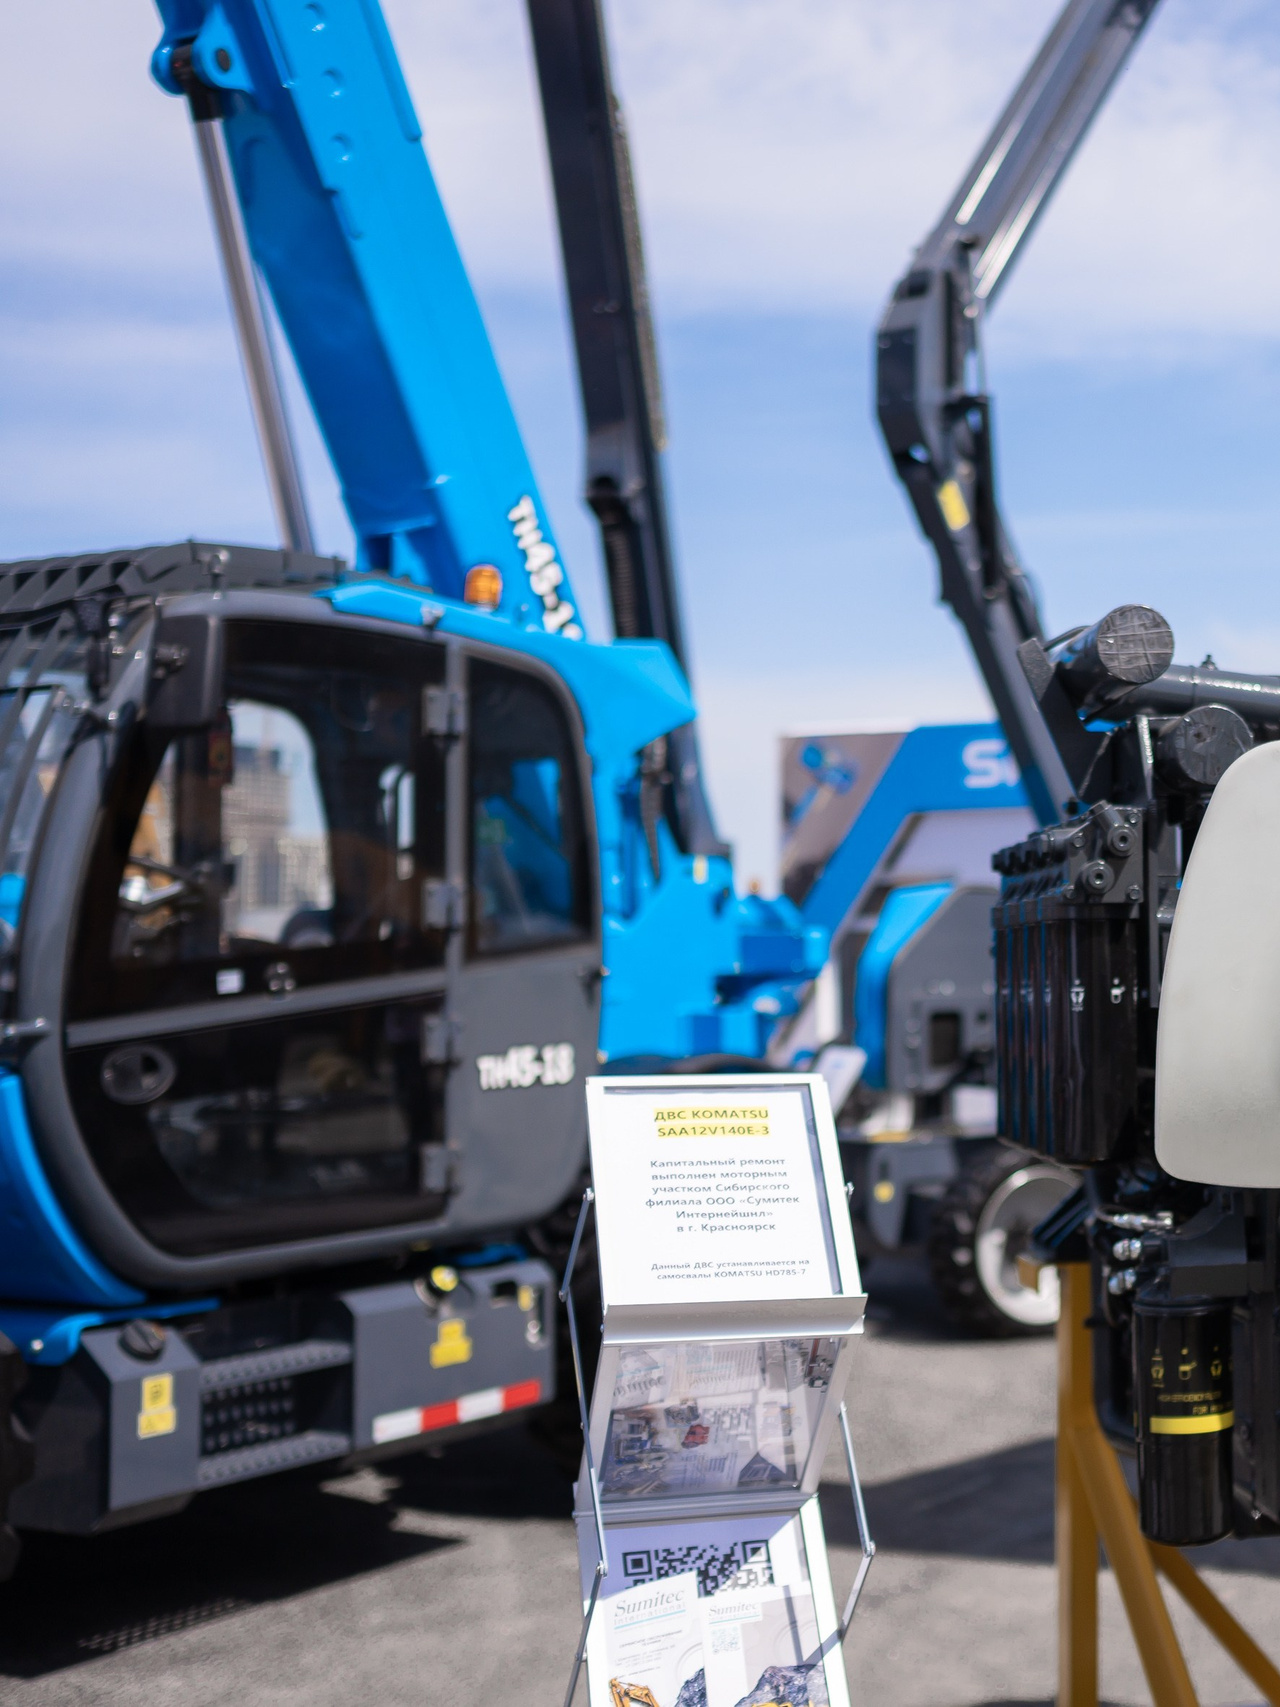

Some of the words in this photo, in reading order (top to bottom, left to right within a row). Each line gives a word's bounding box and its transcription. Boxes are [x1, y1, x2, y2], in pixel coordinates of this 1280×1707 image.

[654, 1110, 686, 1122] ДВС
[691, 1109, 769, 1119] KOMATSU
[657, 1126, 770, 1137] SAA12V140E-3
[650, 1157, 736, 1168] Капитальный
[740, 1158, 785, 1167] ремонт
[651, 1172, 716, 1181] выполнен
[720, 1170, 787, 1180] моторным
[651, 1185, 711, 1195] участком
[715, 1183, 790, 1193] Сибирского
[645, 1198, 702, 1208] филиала
[706, 1197, 735, 1205] ООО
[739, 1196, 800, 1206] «Сумитек
[701, 1223, 776, 1233] Красноярск
[651, 1262, 691, 1271] Данный
[693, 1261, 714, 1270] ДВС
[716, 1259, 795, 1269] устанавливается
[714, 1270, 762, 1278] KOMATSU
[614, 1590, 685, 1617] Sumitec
[709, 1601, 759, 1617] Sumitec
